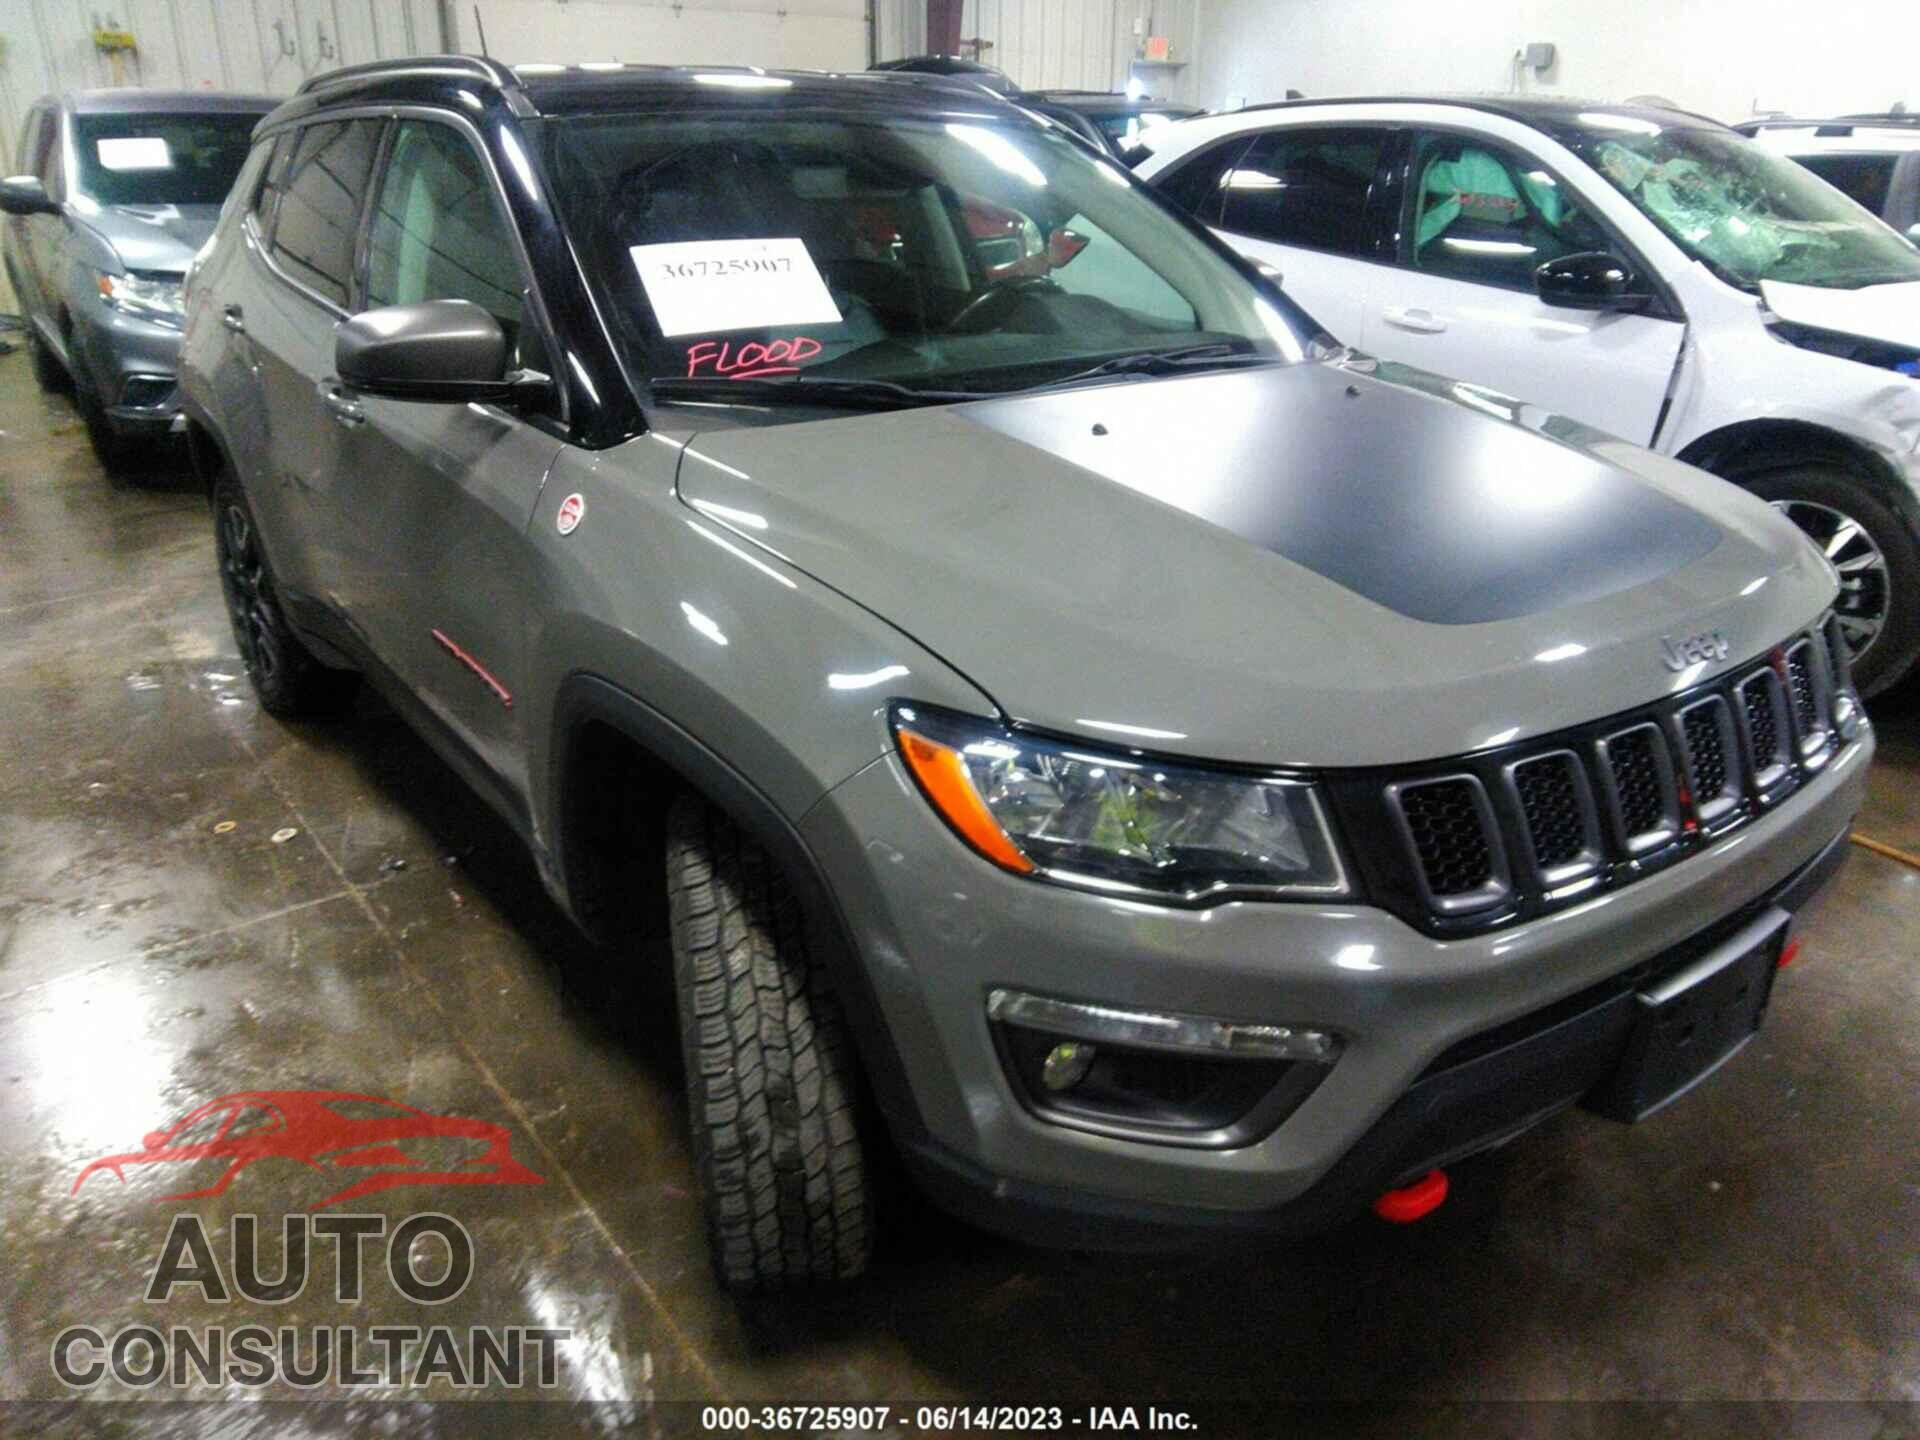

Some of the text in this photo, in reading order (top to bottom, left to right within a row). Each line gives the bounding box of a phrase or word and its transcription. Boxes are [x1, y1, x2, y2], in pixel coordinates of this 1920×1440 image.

[661, 256, 792, 279] 36725907
[687, 336, 822, 379] FLOOD
[1660, 634, 1729, 672] Jeep
